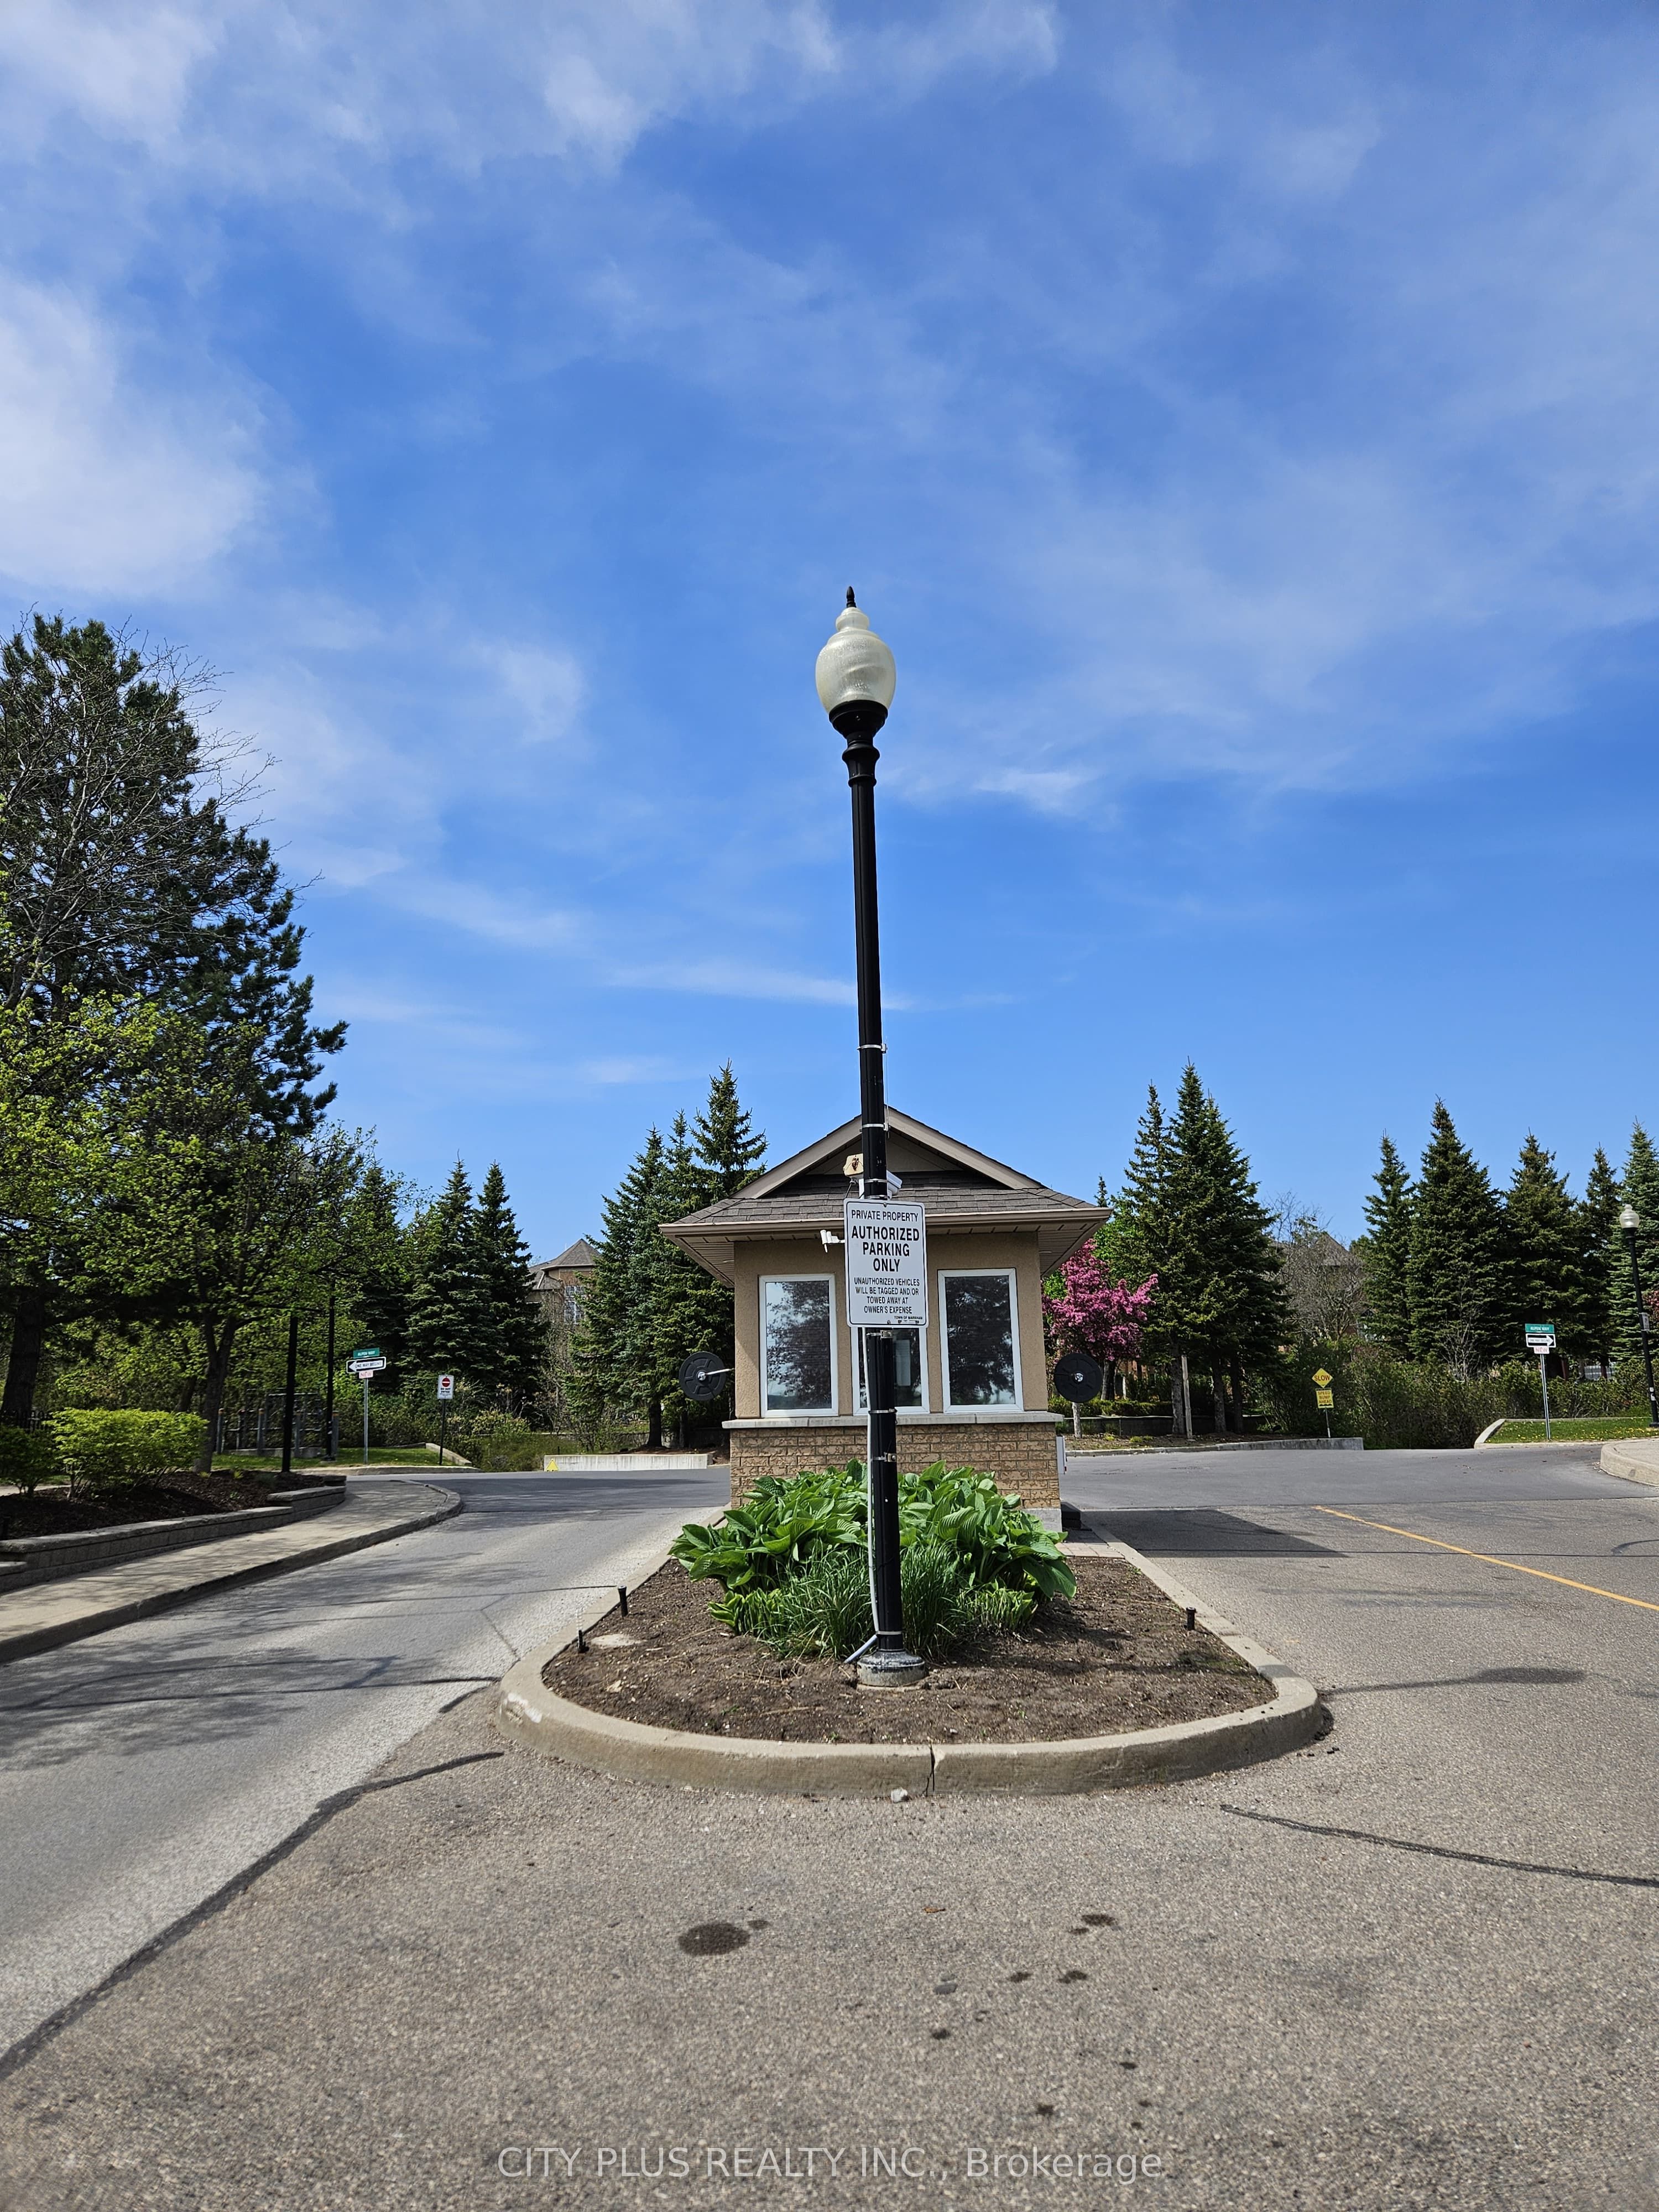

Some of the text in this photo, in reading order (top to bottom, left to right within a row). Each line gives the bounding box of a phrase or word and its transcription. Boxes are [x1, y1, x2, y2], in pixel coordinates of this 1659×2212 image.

[851, 1209, 918, 1222] PRIVATE PROPERTY
[852, 1225, 919, 1241] AUTHORIZED
[863, 1241, 910, 1256] PARKING
[873, 1258, 900, 1272] ONLY
[854, 1277, 920, 1286] UNAUTHORIZED VEHICLES
